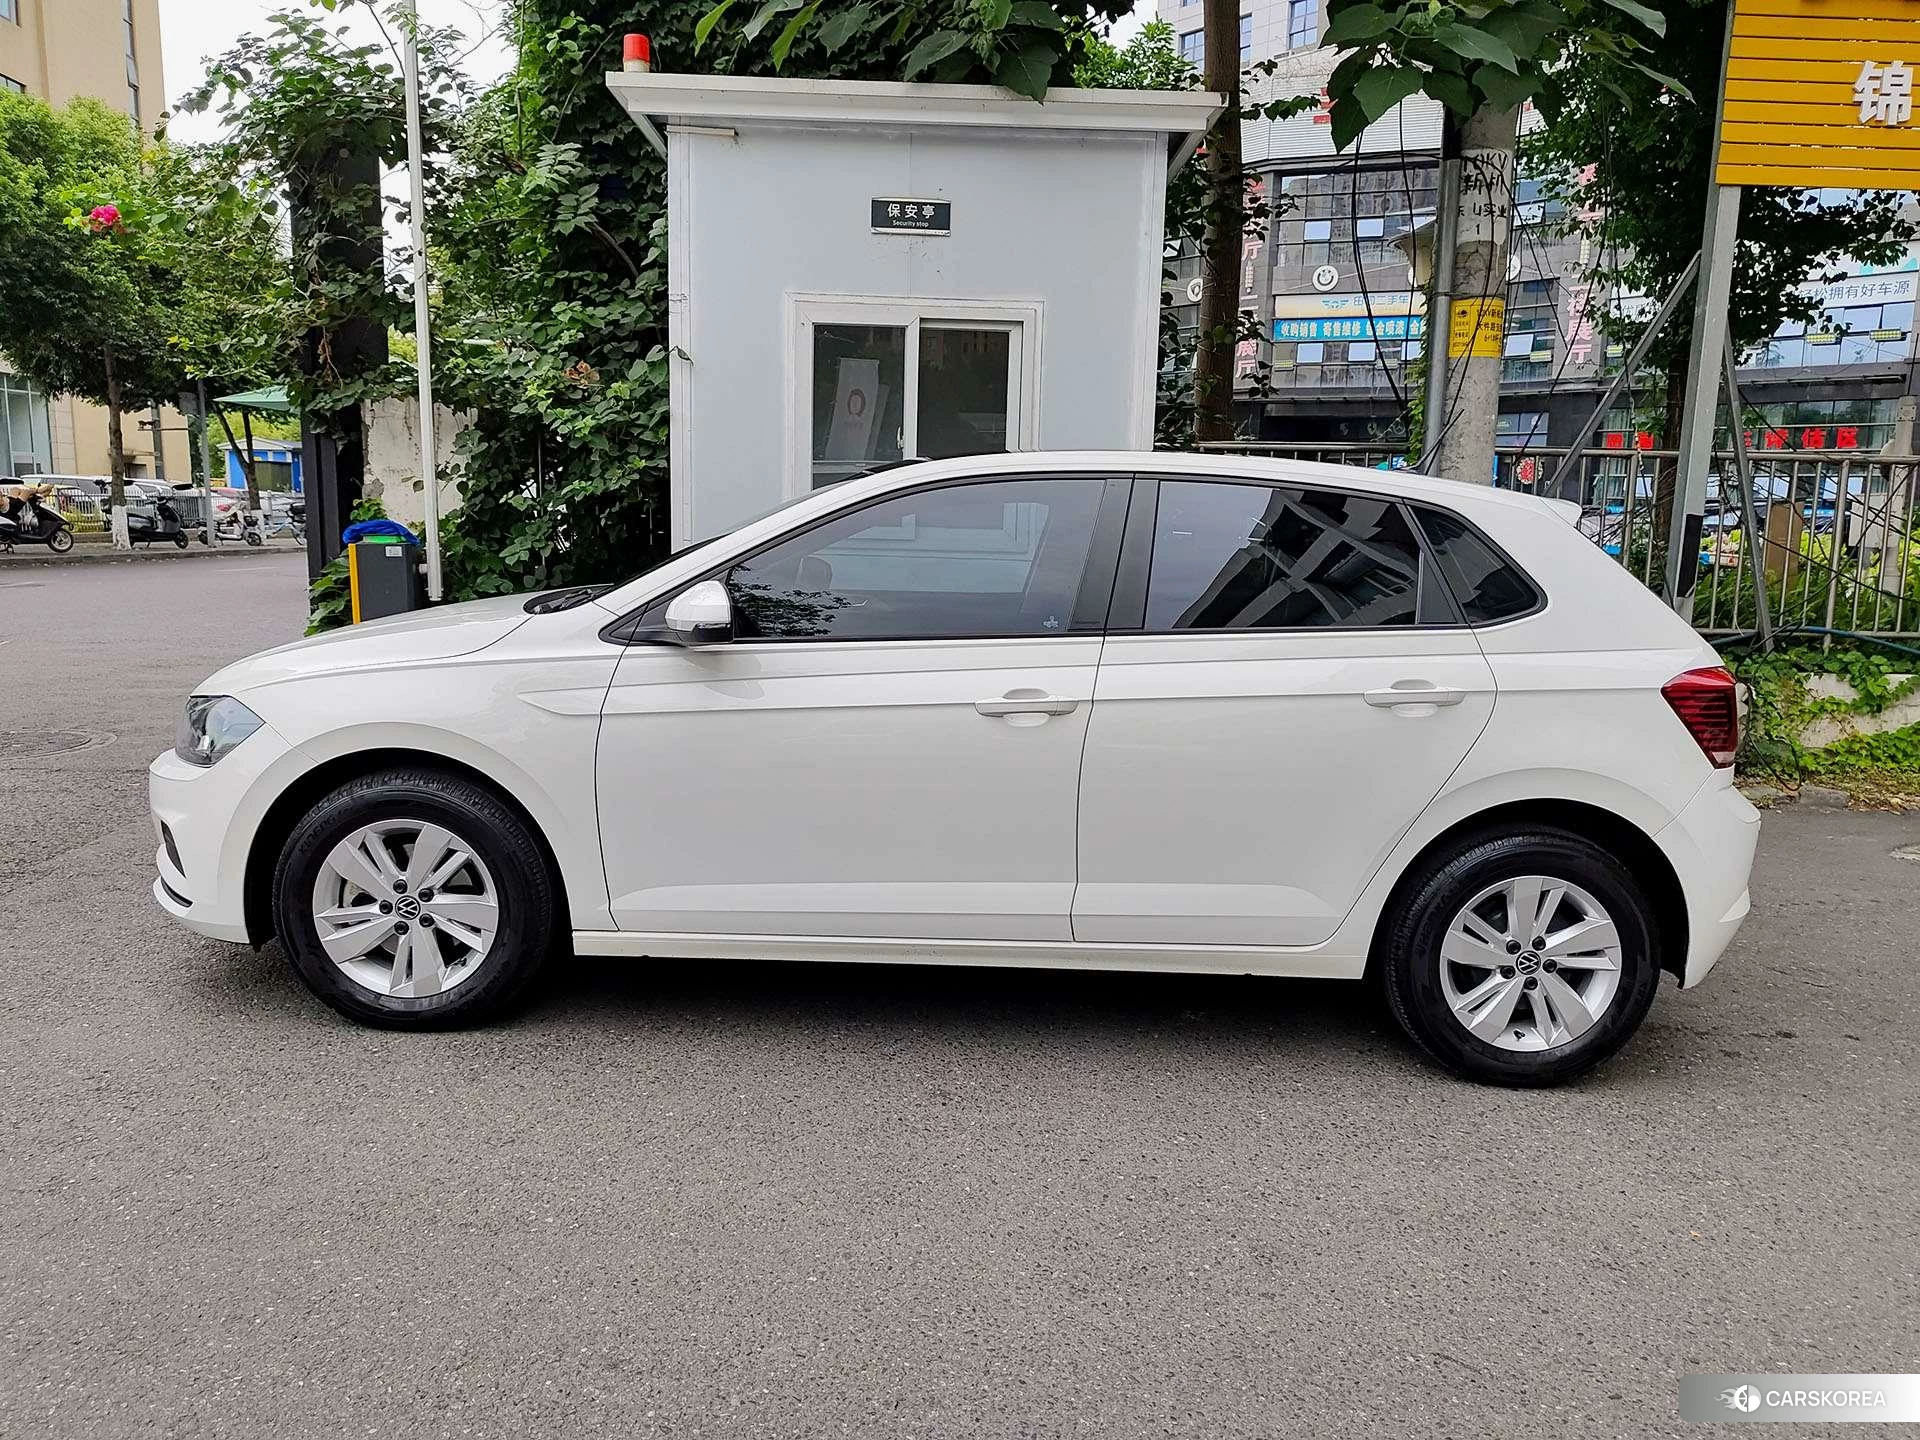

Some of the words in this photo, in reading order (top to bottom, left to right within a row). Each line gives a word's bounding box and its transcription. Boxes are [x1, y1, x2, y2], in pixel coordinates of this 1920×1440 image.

[1852, 60, 1914, 125] 锦
[887, 203, 936, 219] 保安亭
[893, 220, 915, 228] Security
